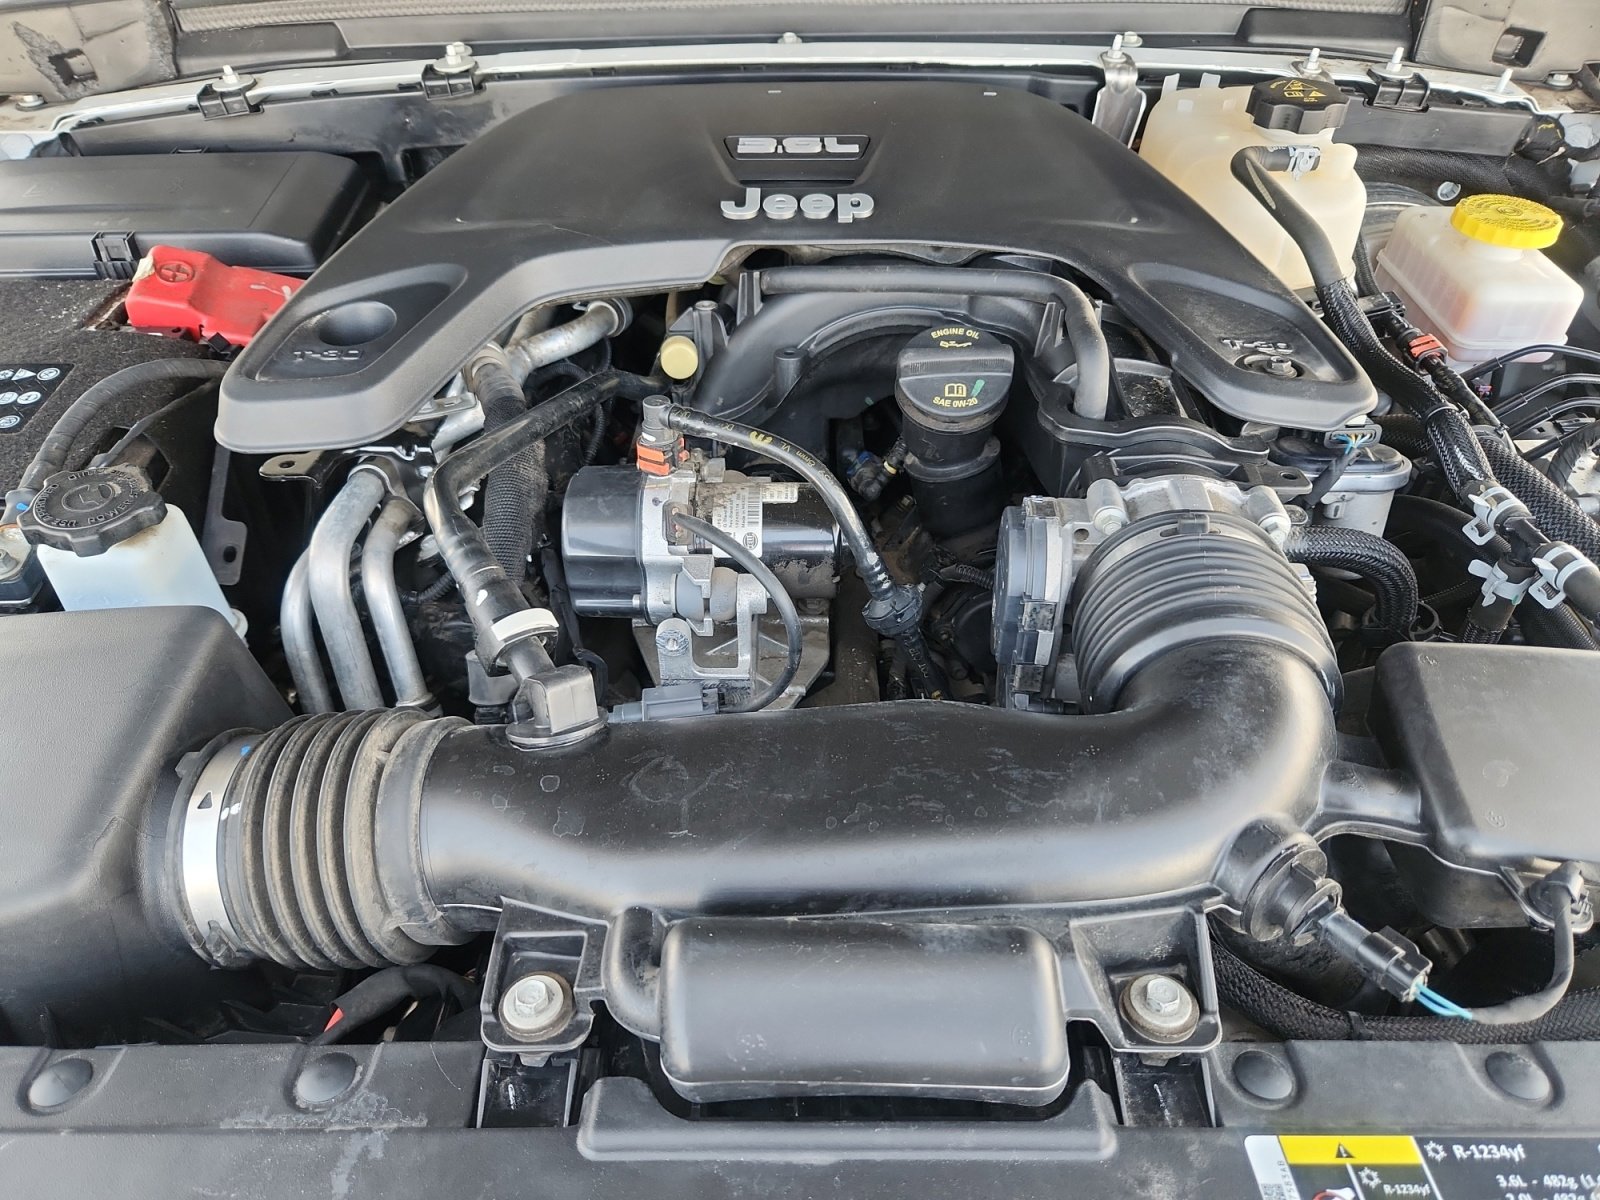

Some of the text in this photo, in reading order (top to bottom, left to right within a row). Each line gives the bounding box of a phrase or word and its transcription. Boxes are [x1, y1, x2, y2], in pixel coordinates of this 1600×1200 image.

[737, 137, 860, 154] 3.6L
[720, 187, 875, 224] Jeep
[930, 327, 980, 340] ENGINE OIL
[932, 396, 978, 408] SAE 0W-20
[87, 498, 132, 525] POWER
[51, 517, 78, 528] USE
[1452, 1143, 1526, 1163] R-1234yf
[1383, 1184, 1431, 1197] R-1234yf
[1495, 1174, 1528, 1188] 3.6L
[1543, 1174, 1579, 1191] 482g
